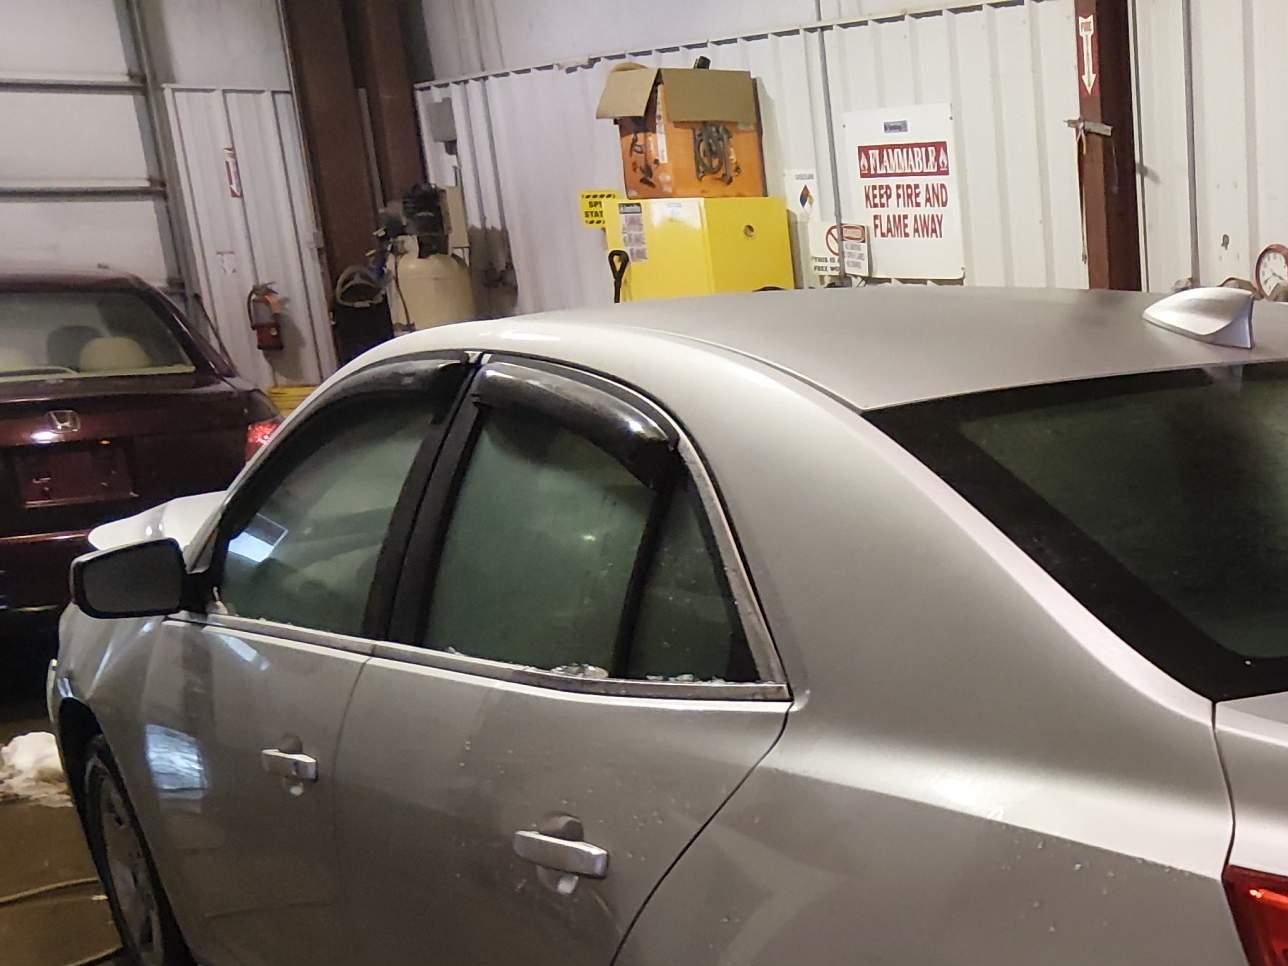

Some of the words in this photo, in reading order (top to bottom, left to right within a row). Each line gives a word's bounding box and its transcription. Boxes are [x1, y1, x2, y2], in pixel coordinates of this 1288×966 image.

[869, 147, 938, 175] FLAMMABLE
[864, 184, 892, 208] KEEP
[895, 183, 922, 208] FIRE
[924, 183, 948, 208] AND
[584, 210, 604, 218] STAT
[873, 214, 909, 238] FLAME
[913, 214, 943, 239] AWAY
